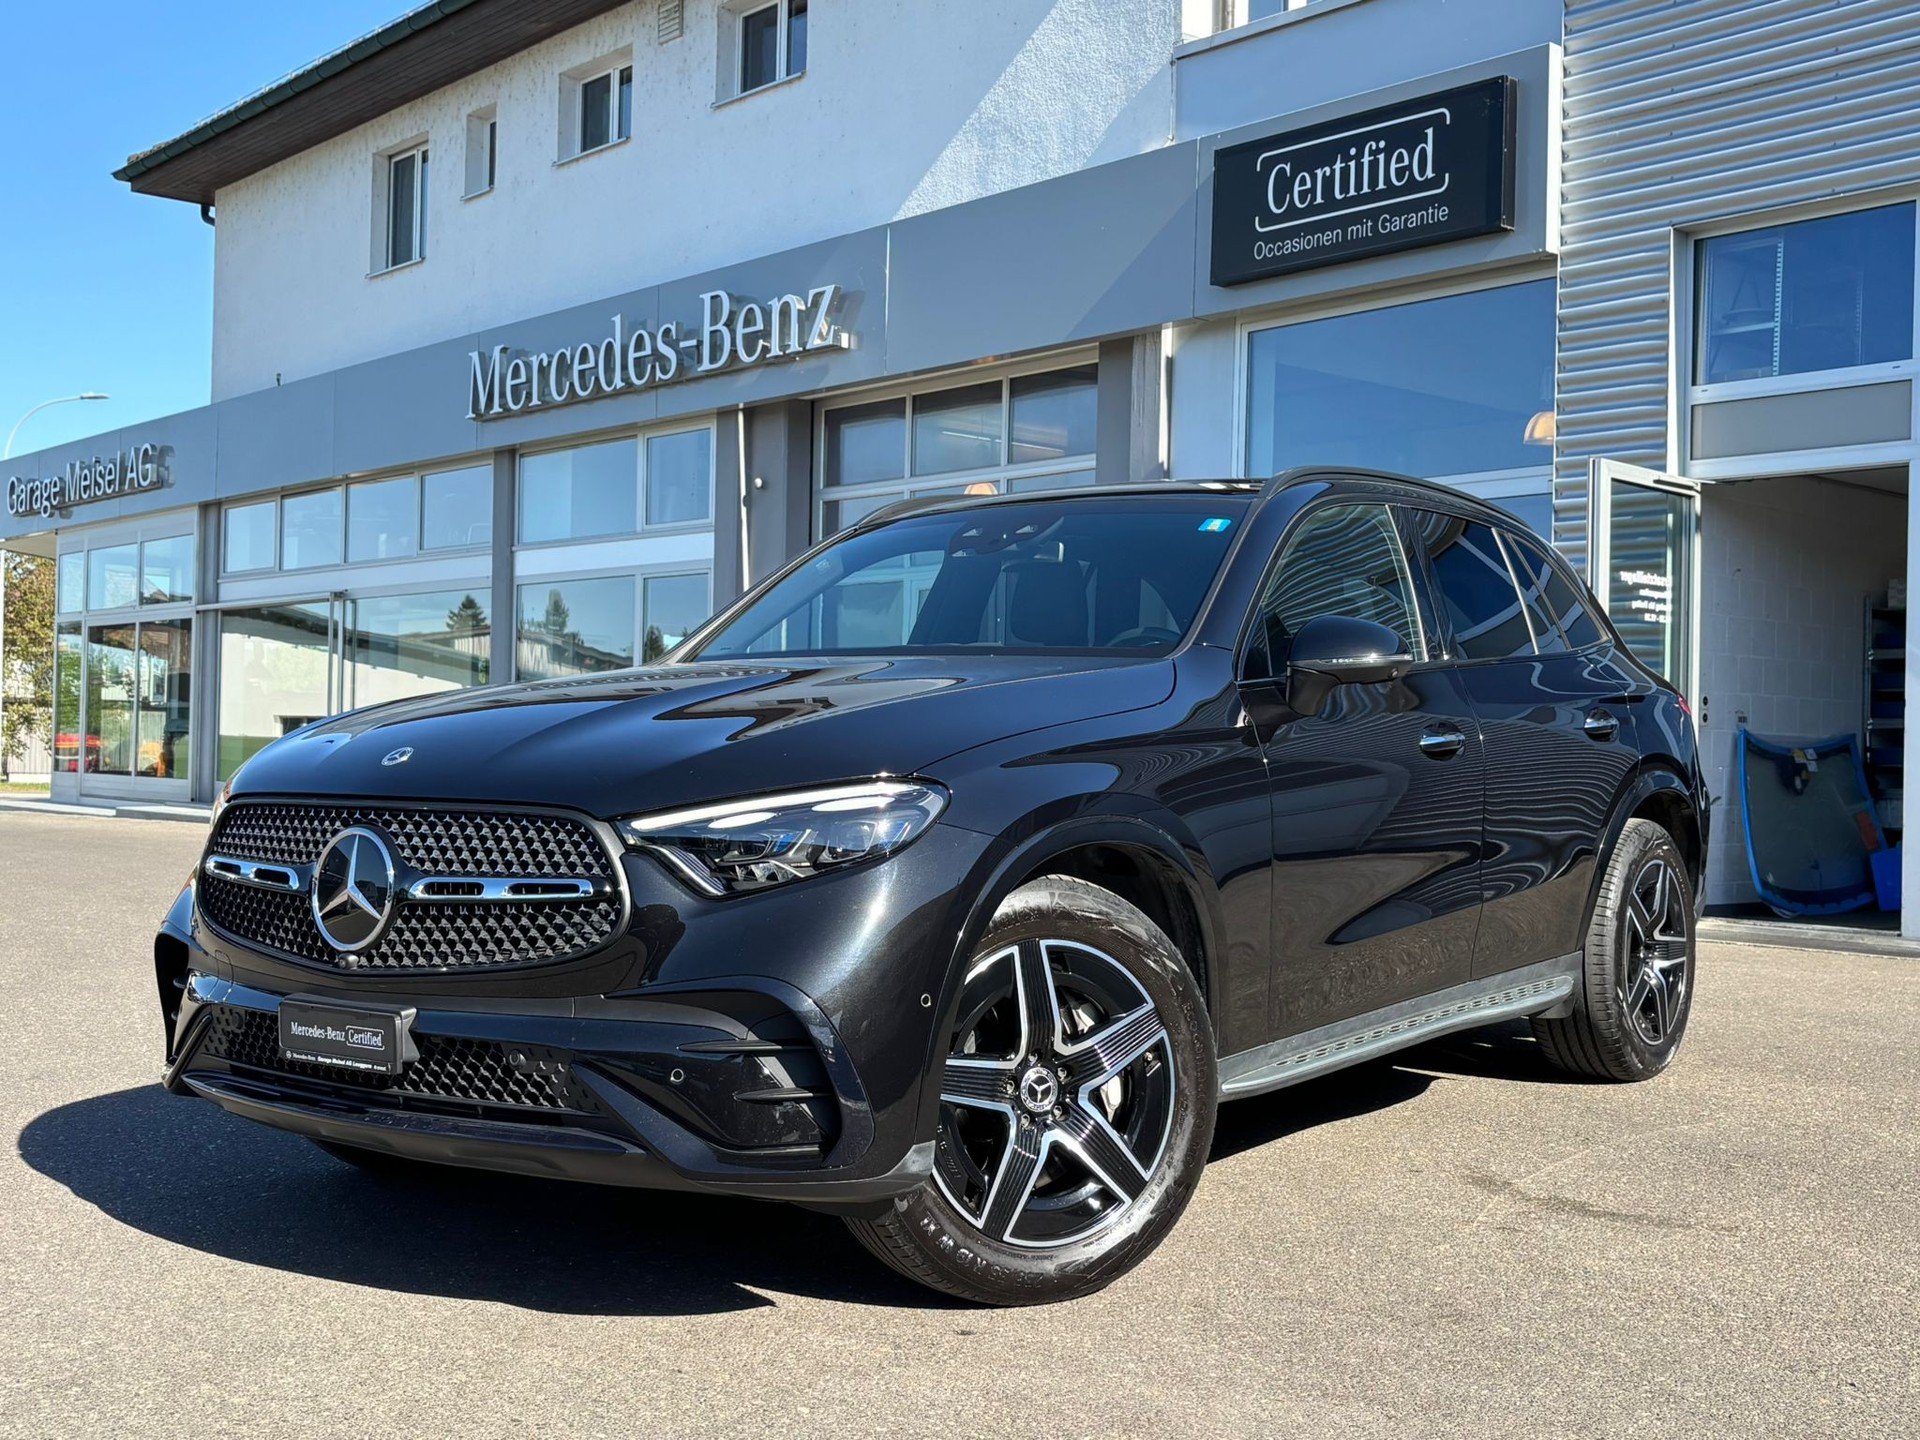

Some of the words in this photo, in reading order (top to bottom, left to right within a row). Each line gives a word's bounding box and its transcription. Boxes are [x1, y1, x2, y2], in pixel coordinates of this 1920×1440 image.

[1267, 127, 1436, 215] Certified
[1253, 223, 1342, 260] Occasionen
[1347, 214, 1373, 241] mit
[1377, 202, 1449, 234] Garantie
[465, 283, 844, 420] Mercedes-Benz
[7, 475, 60, 518] Garage
[65, 450, 120, 503] Meisel
[125, 443, 153, 487] AG
[291, 1021, 346, 1041] Mercedes-Benz
[348, 1025, 382, 1047] Certified
